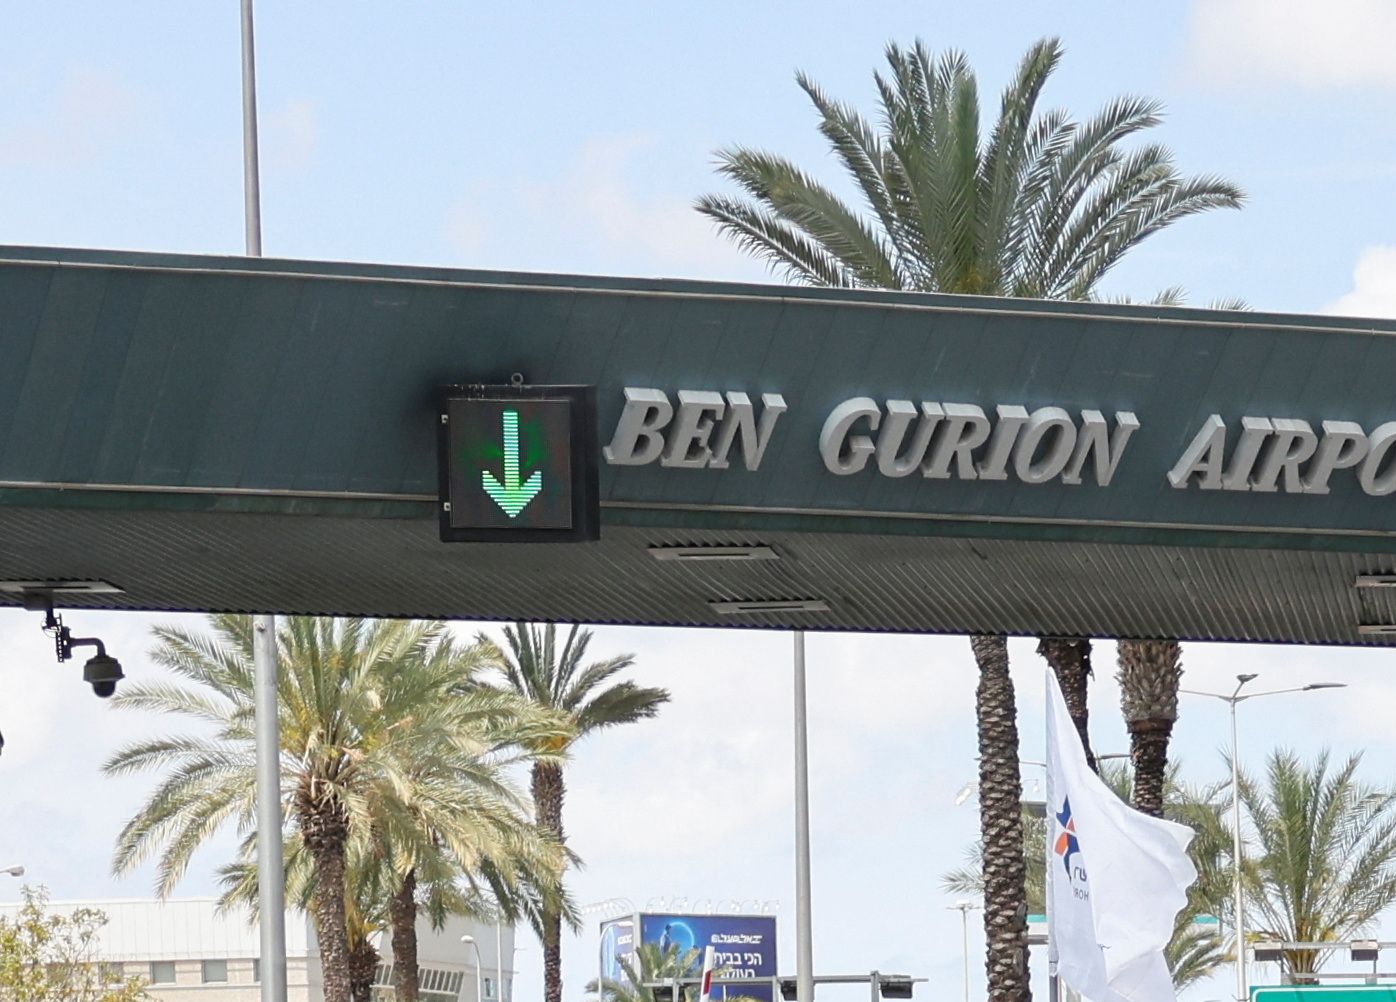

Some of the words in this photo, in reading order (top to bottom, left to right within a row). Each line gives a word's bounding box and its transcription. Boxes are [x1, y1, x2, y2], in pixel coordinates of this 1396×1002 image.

[603, 387, 787, 471] BEN
[820, 397, 1141, 487] GURION
[714, 952, 742, 965] בבית
[744, 952, 762, 965] הכי
